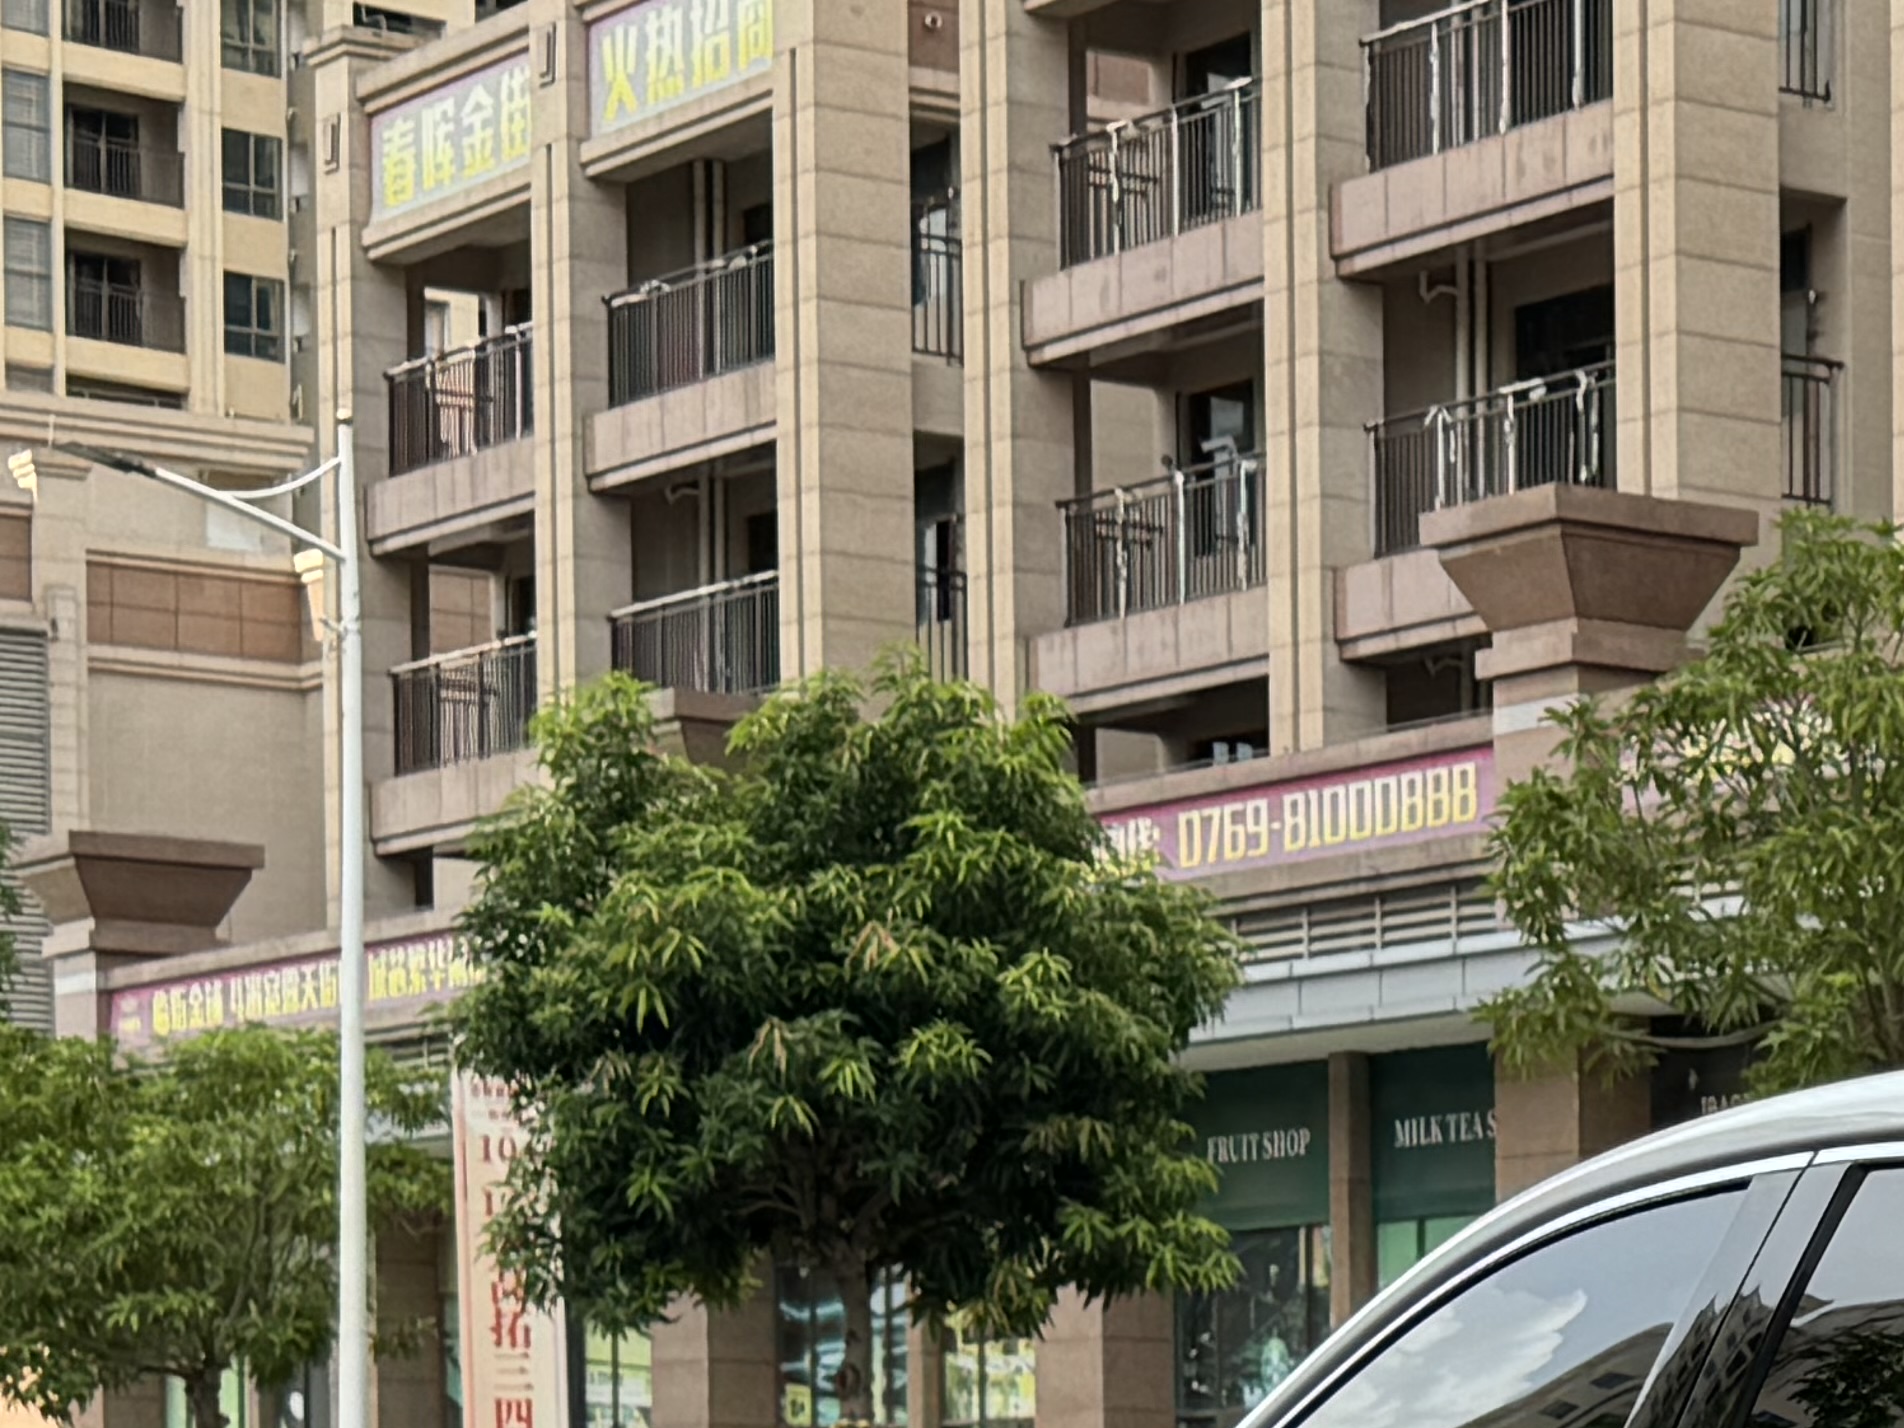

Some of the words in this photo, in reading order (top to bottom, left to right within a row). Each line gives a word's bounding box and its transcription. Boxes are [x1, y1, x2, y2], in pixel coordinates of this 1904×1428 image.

[1177, 761, 1478, 869] 0769-81000888
[1207, 1133, 1260, 1163] FRUIT
[1262, 1128, 1311, 1159] SHOP
[1394, 1114, 1443, 1148] MILK
[1445, 1110, 1484, 1142] TEA
